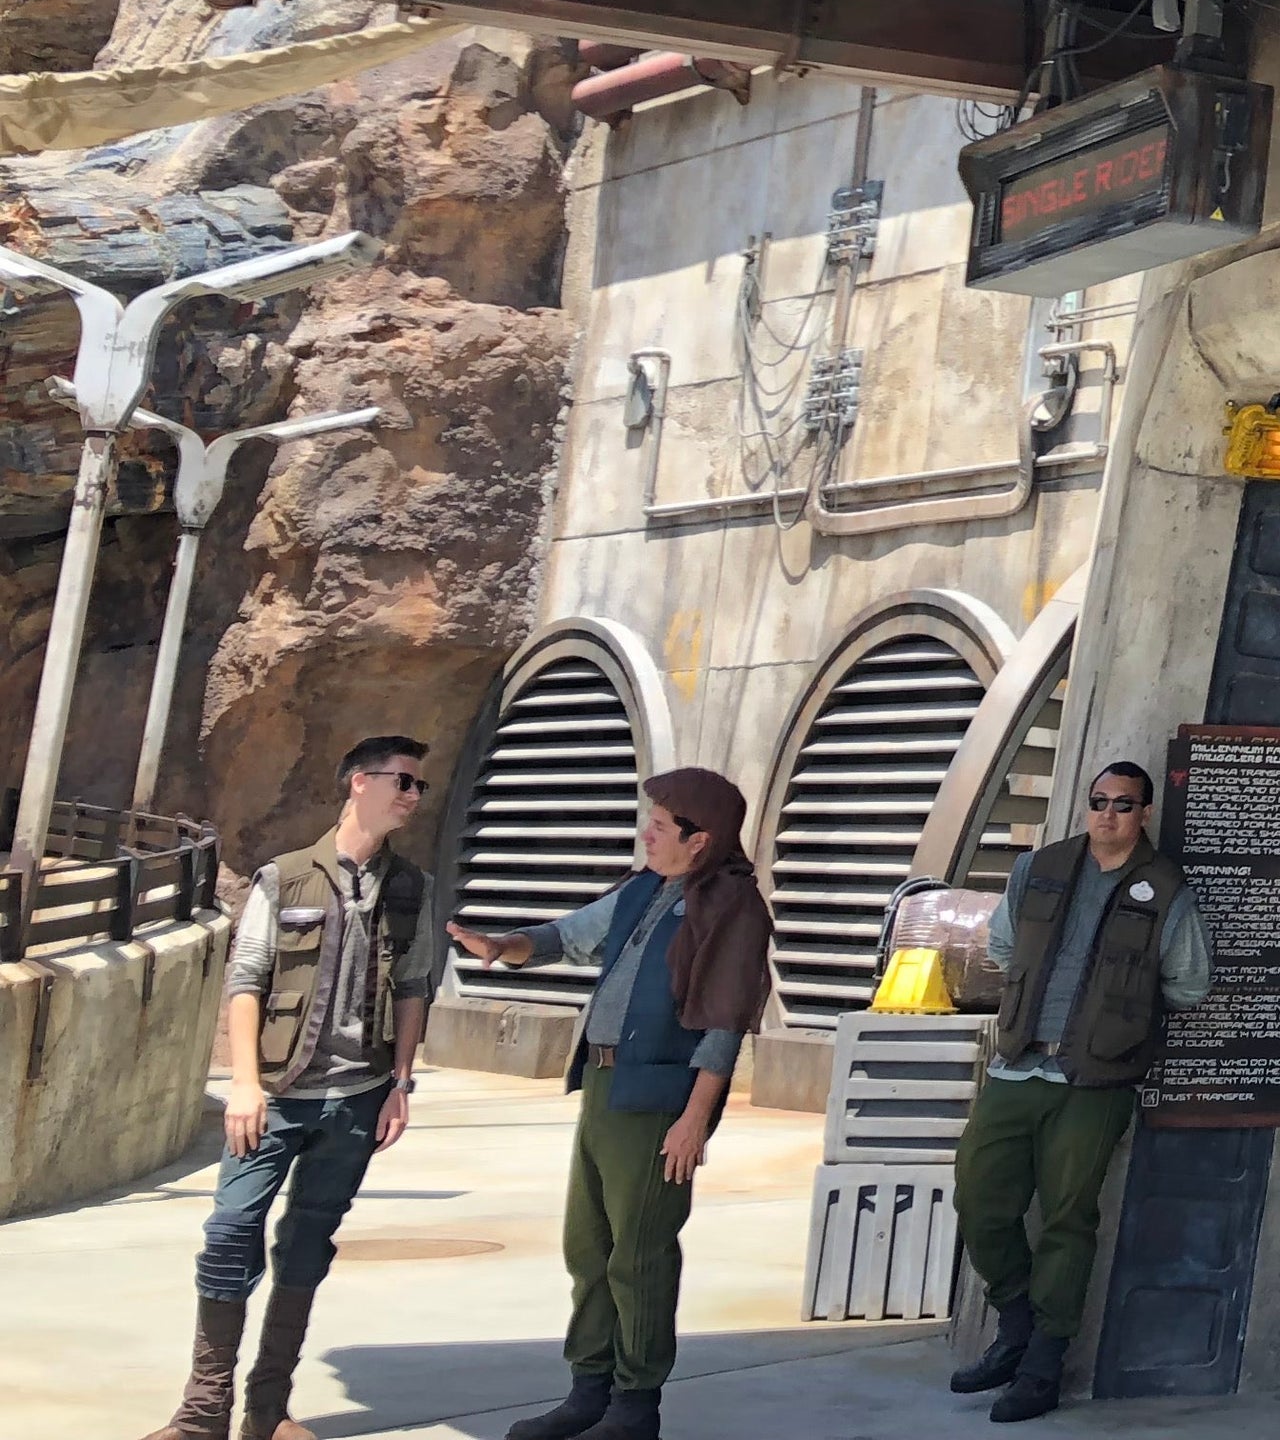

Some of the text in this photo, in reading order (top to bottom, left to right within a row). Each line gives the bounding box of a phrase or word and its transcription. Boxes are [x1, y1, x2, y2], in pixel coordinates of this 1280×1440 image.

[1002, 168, 1089, 230] SINGLE
[1191, 744, 1264, 754] MILLENNIUM
[1190, 753, 1263, 763] SMUGGLERS
[1189, 776, 1250, 785] SOLUTIONS
[1187, 793, 1210, 802] FOR
[1212, 794, 1276, 803] SCHEDULED
[1243, 804, 1280, 812] FLIGHT
[1185, 811, 1236, 819] MEMBERS
[1185, 820, 1241, 828] PREPARED
[1224, 838, 1248, 846] AND
[1183, 846, 1221, 854] DROPS
[1222, 847, 1261, 855] ALONG
[1182, 865, 1251, 876] WARNING!
[1206, 878, 1247, 886] SAFETY,
[1250, 878, 1272, 886] YOU
[1167, 1030, 1212, 1038] PERSON
[1214, 1030, 1237, 1038] AGE
[1163, 1077, 1239, 1085] REQUIREMENT
[1162, 1093, 1193, 1101] MUST
